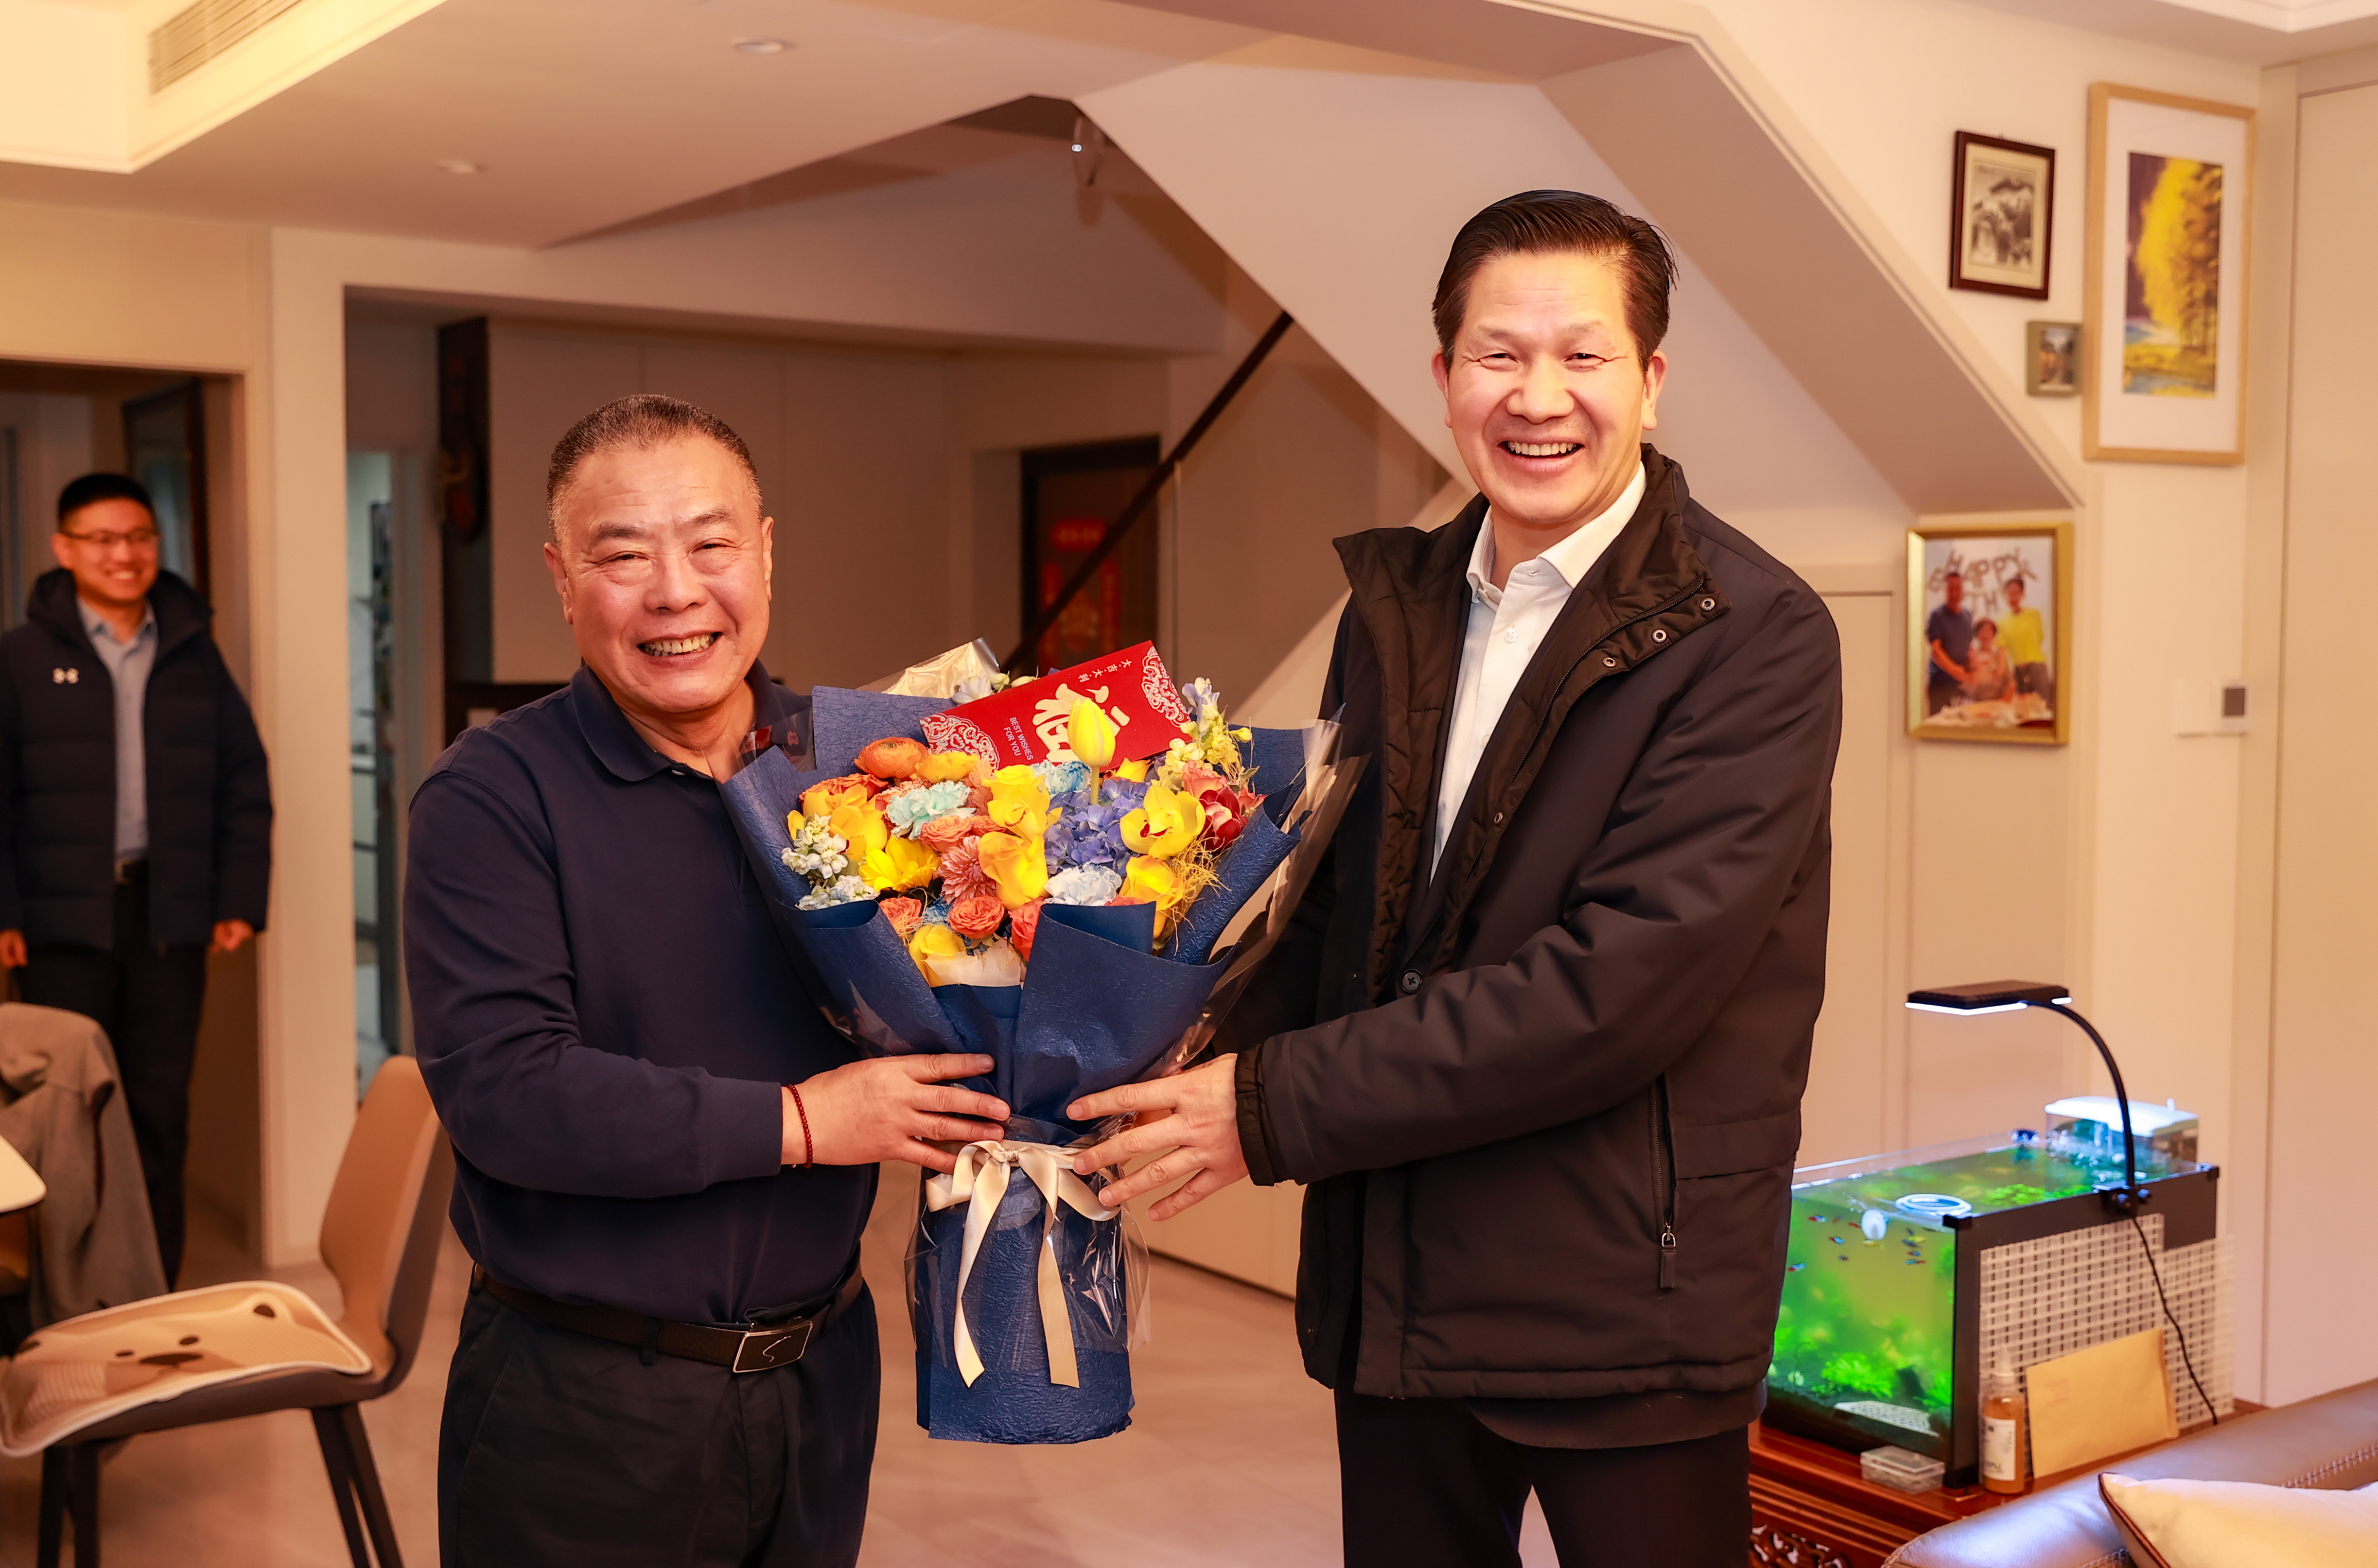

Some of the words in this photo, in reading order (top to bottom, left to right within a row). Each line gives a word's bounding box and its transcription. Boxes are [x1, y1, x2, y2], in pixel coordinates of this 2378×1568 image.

[1003, 727, 1015, 741] FOR
[1010, 741, 1022, 756] YOU
[1010, 717, 1022, 733] BEST
[1017, 733, 1033, 760] WISHES
